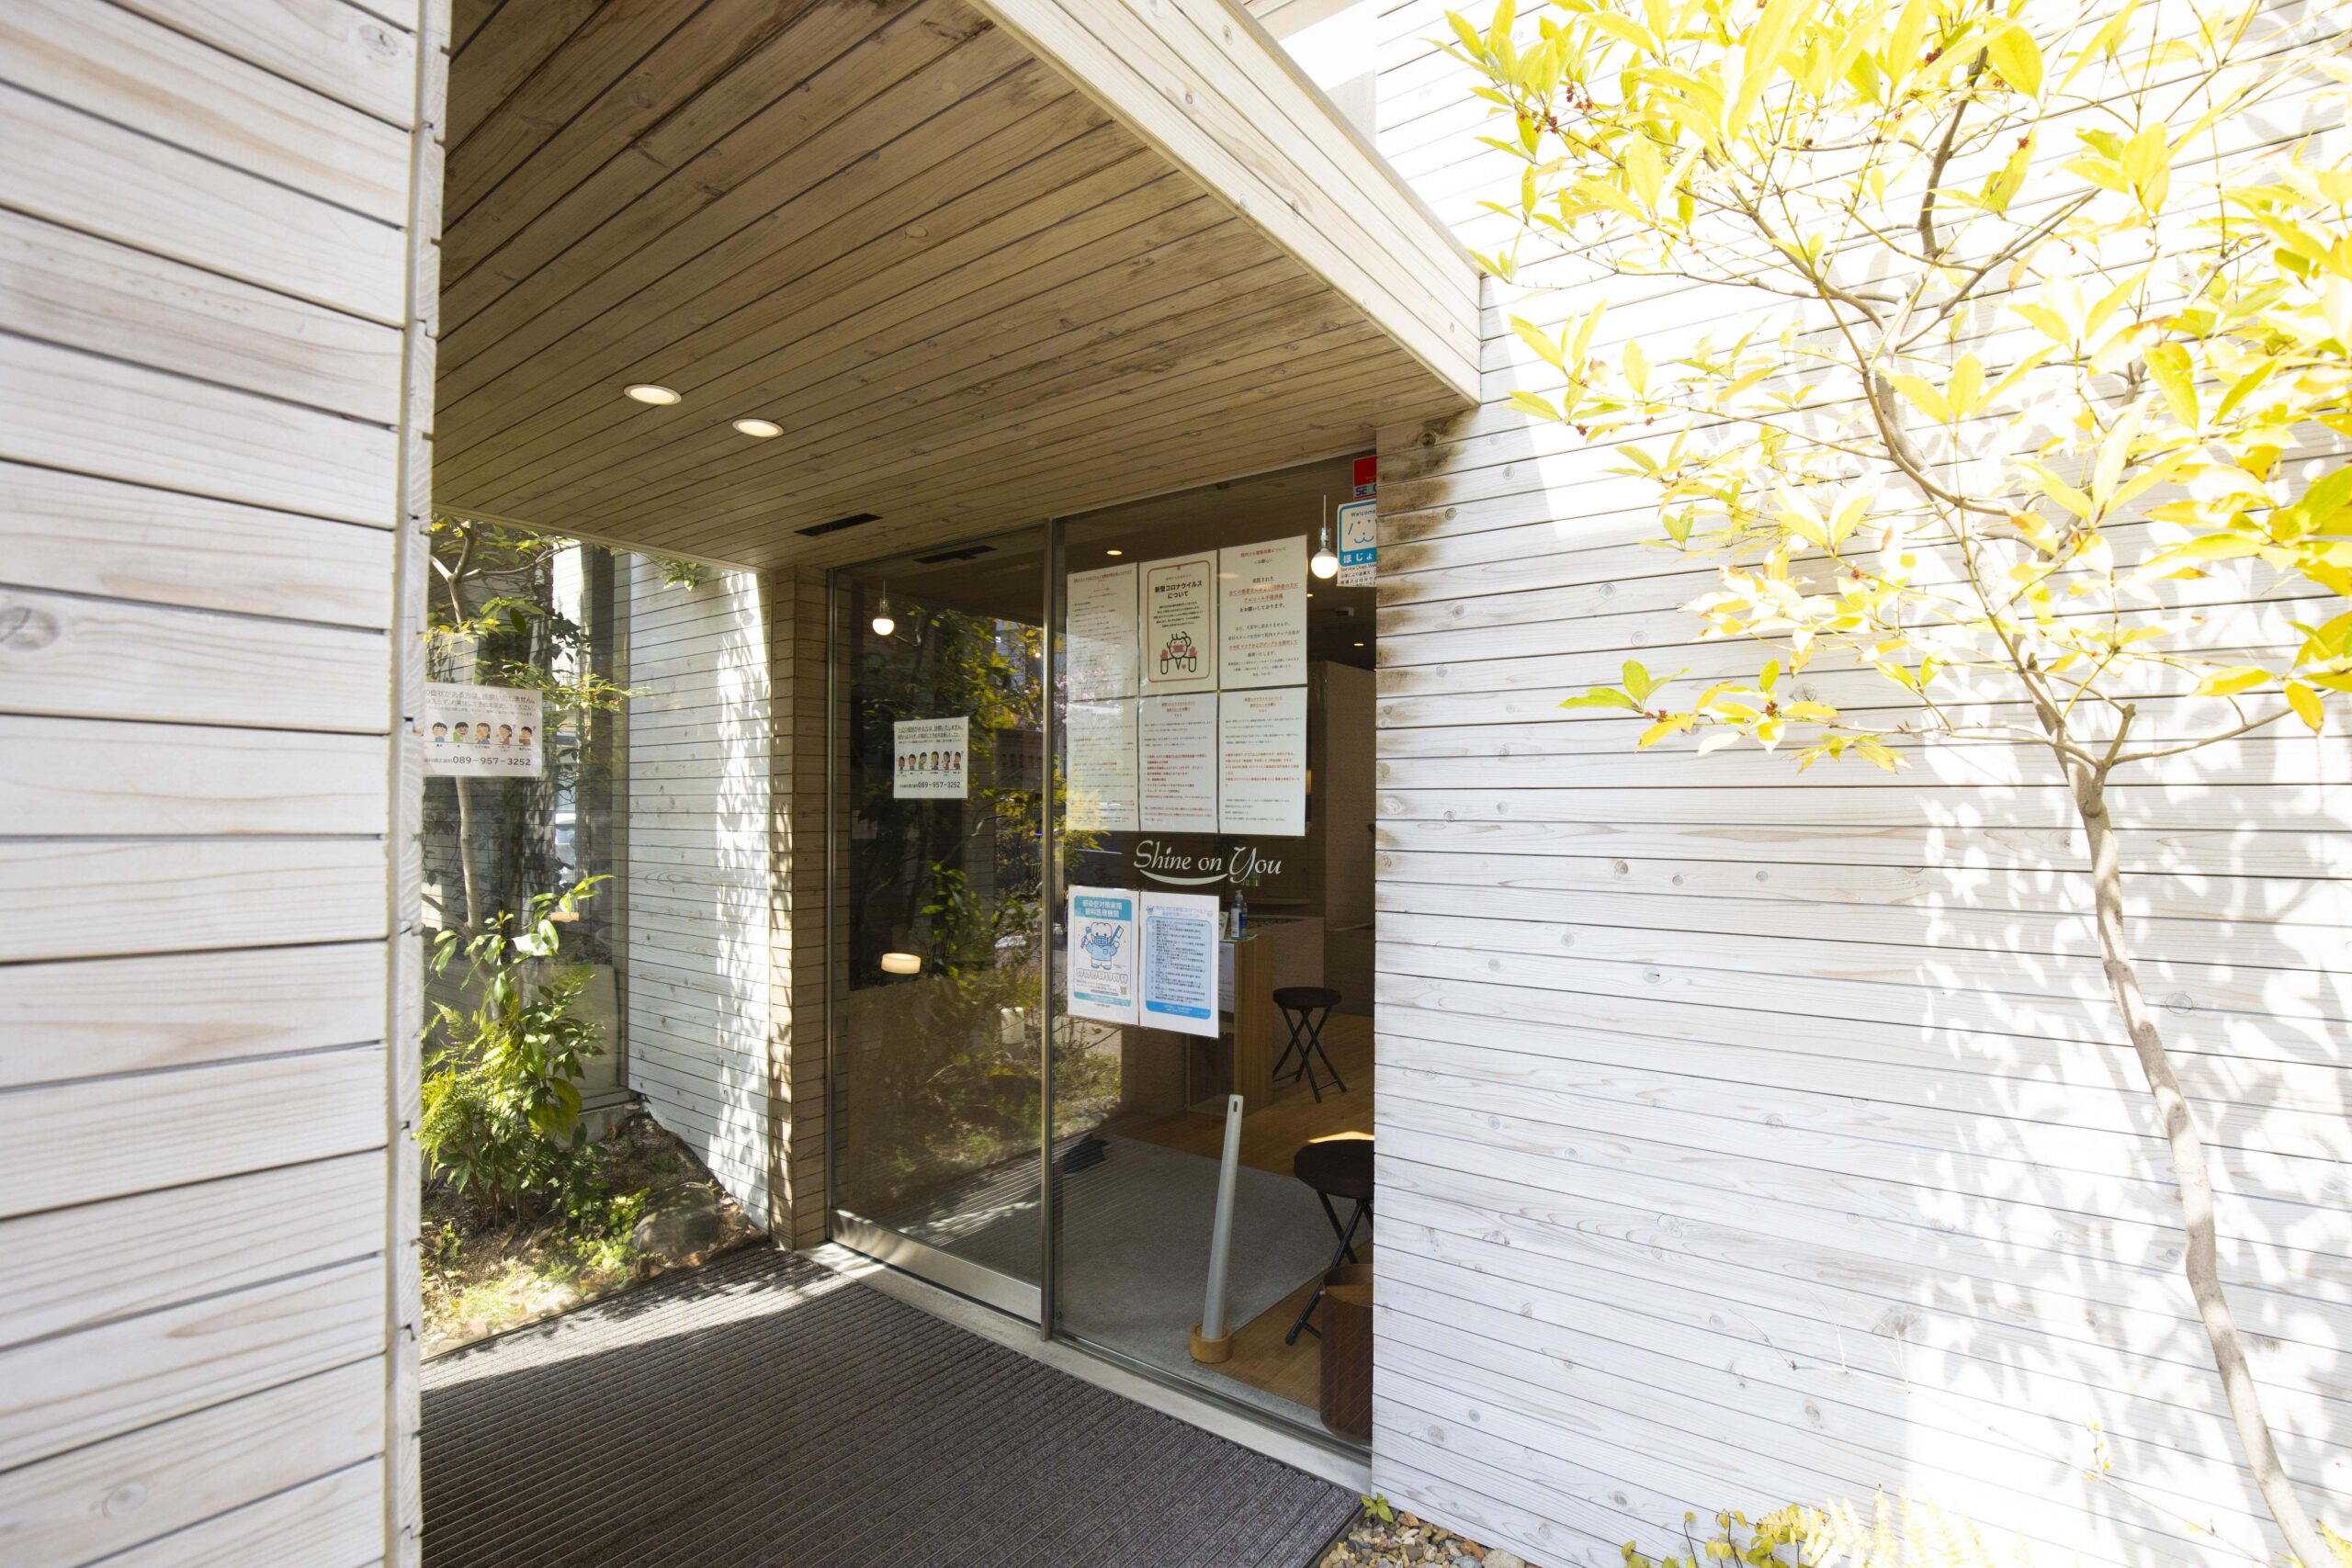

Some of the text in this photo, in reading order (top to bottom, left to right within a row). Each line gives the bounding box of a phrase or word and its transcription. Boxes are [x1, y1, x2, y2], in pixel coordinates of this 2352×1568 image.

[1344, 553, 1373, 563] ほじょ
[1155, 581, 1203, 592] 新型コロナウイルス
[1134, 840, 1281, 884] Shine on You
